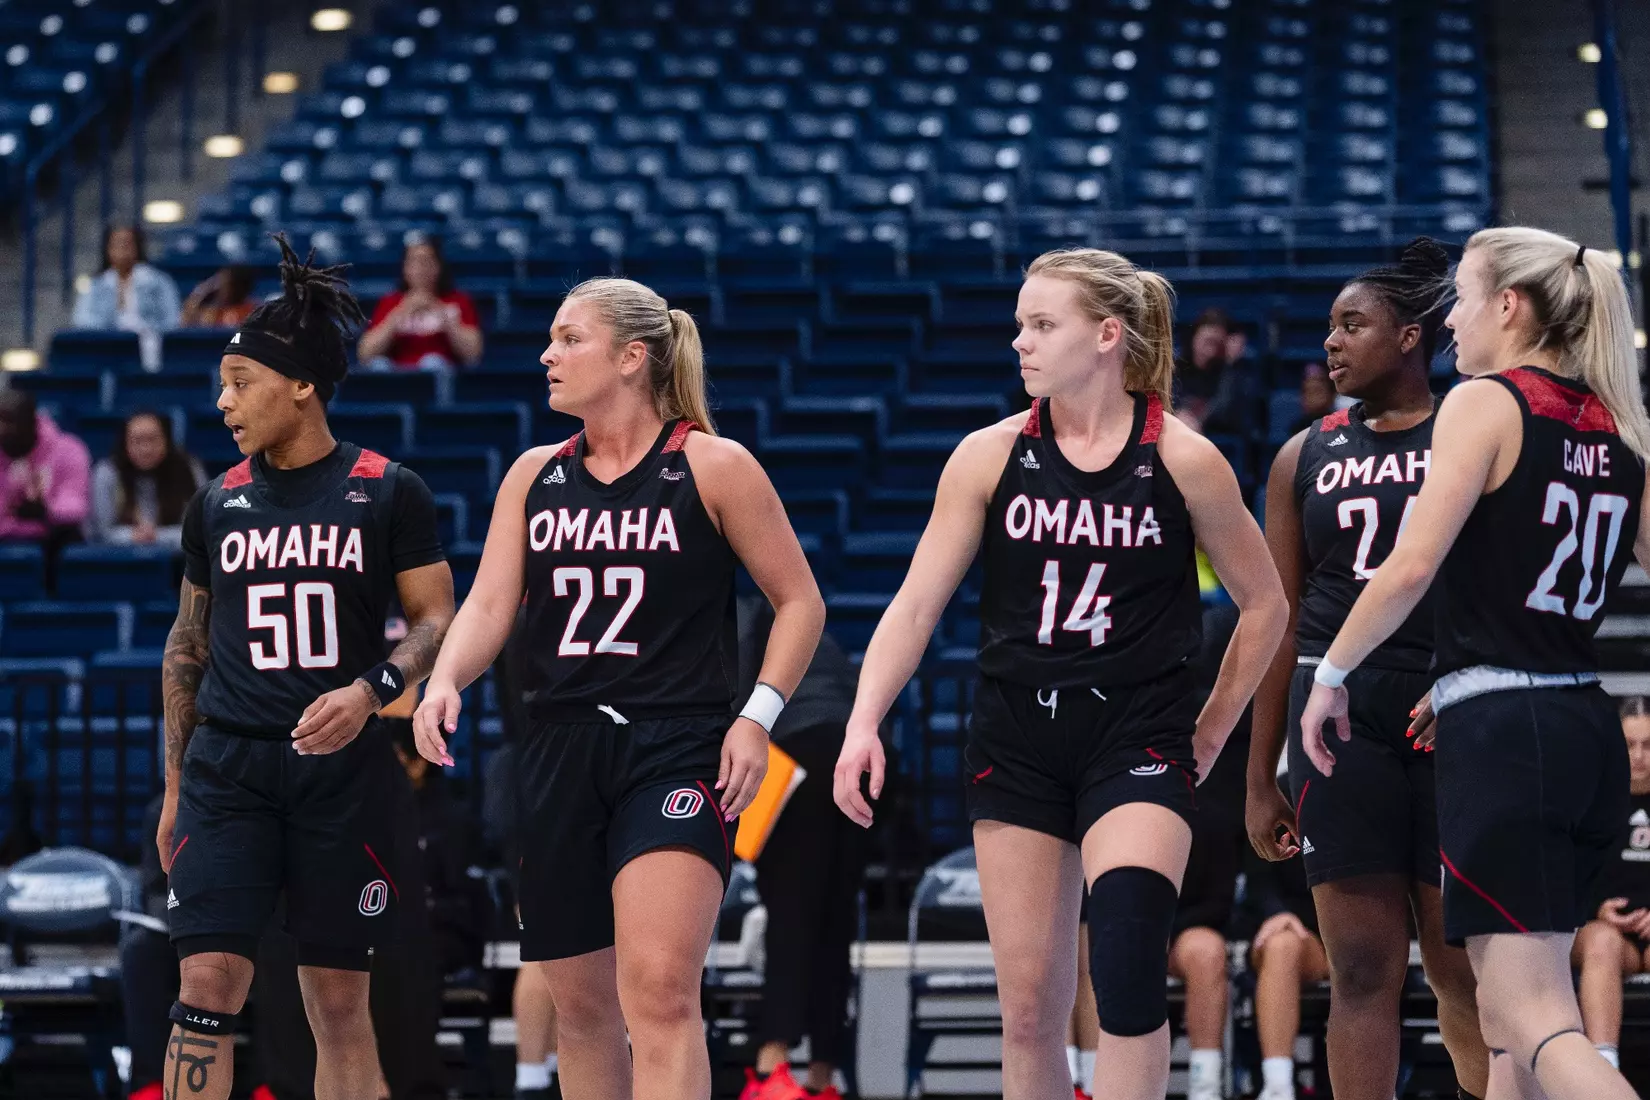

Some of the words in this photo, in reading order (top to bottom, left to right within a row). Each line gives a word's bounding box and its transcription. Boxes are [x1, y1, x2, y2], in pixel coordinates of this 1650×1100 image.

[1315, 449, 1432, 495] OMAH
[1564, 438, 1611, 477] CAVE
[220, 523, 364, 573] OMAHA
[527, 507, 681, 552] OMAHA
[1005, 494, 1163, 548] OMAHA
[1525, 481, 1629, 620] 20
[246, 581, 340, 671] 50
[552, 566, 645, 658] 22
[1037, 559, 1113, 647] 14
